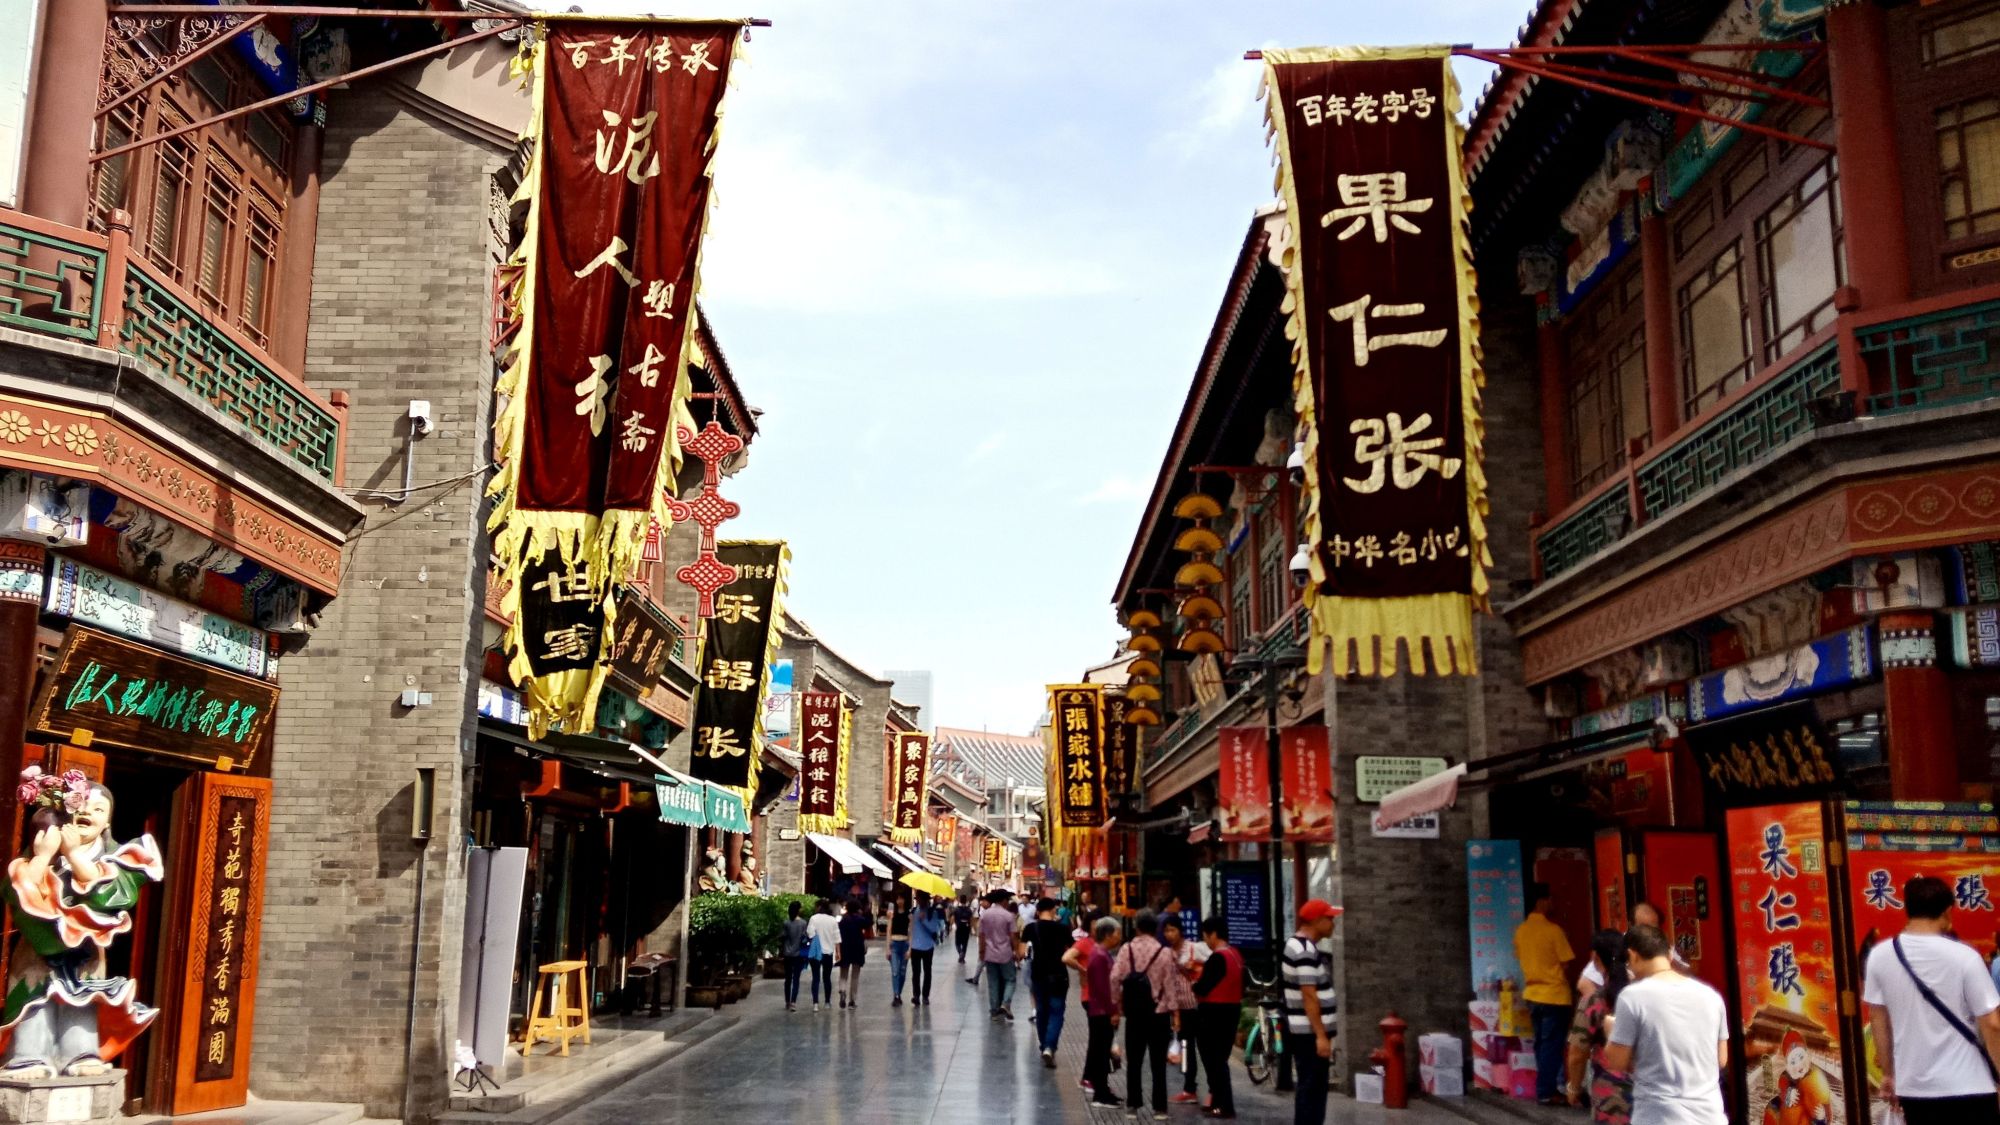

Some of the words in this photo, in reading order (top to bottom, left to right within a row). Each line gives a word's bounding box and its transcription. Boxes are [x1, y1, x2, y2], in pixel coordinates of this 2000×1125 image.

[563, 36, 718, 77] 百年传承
[1297, 87, 1436, 127] 百年老字号
[1321, 172, 1461, 494] 果仁张
[695, 593, 762, 759] 乐器张
[1758, 823, 1805, 998] 果仁張
[1863, 868, 1994, 912] 果張
